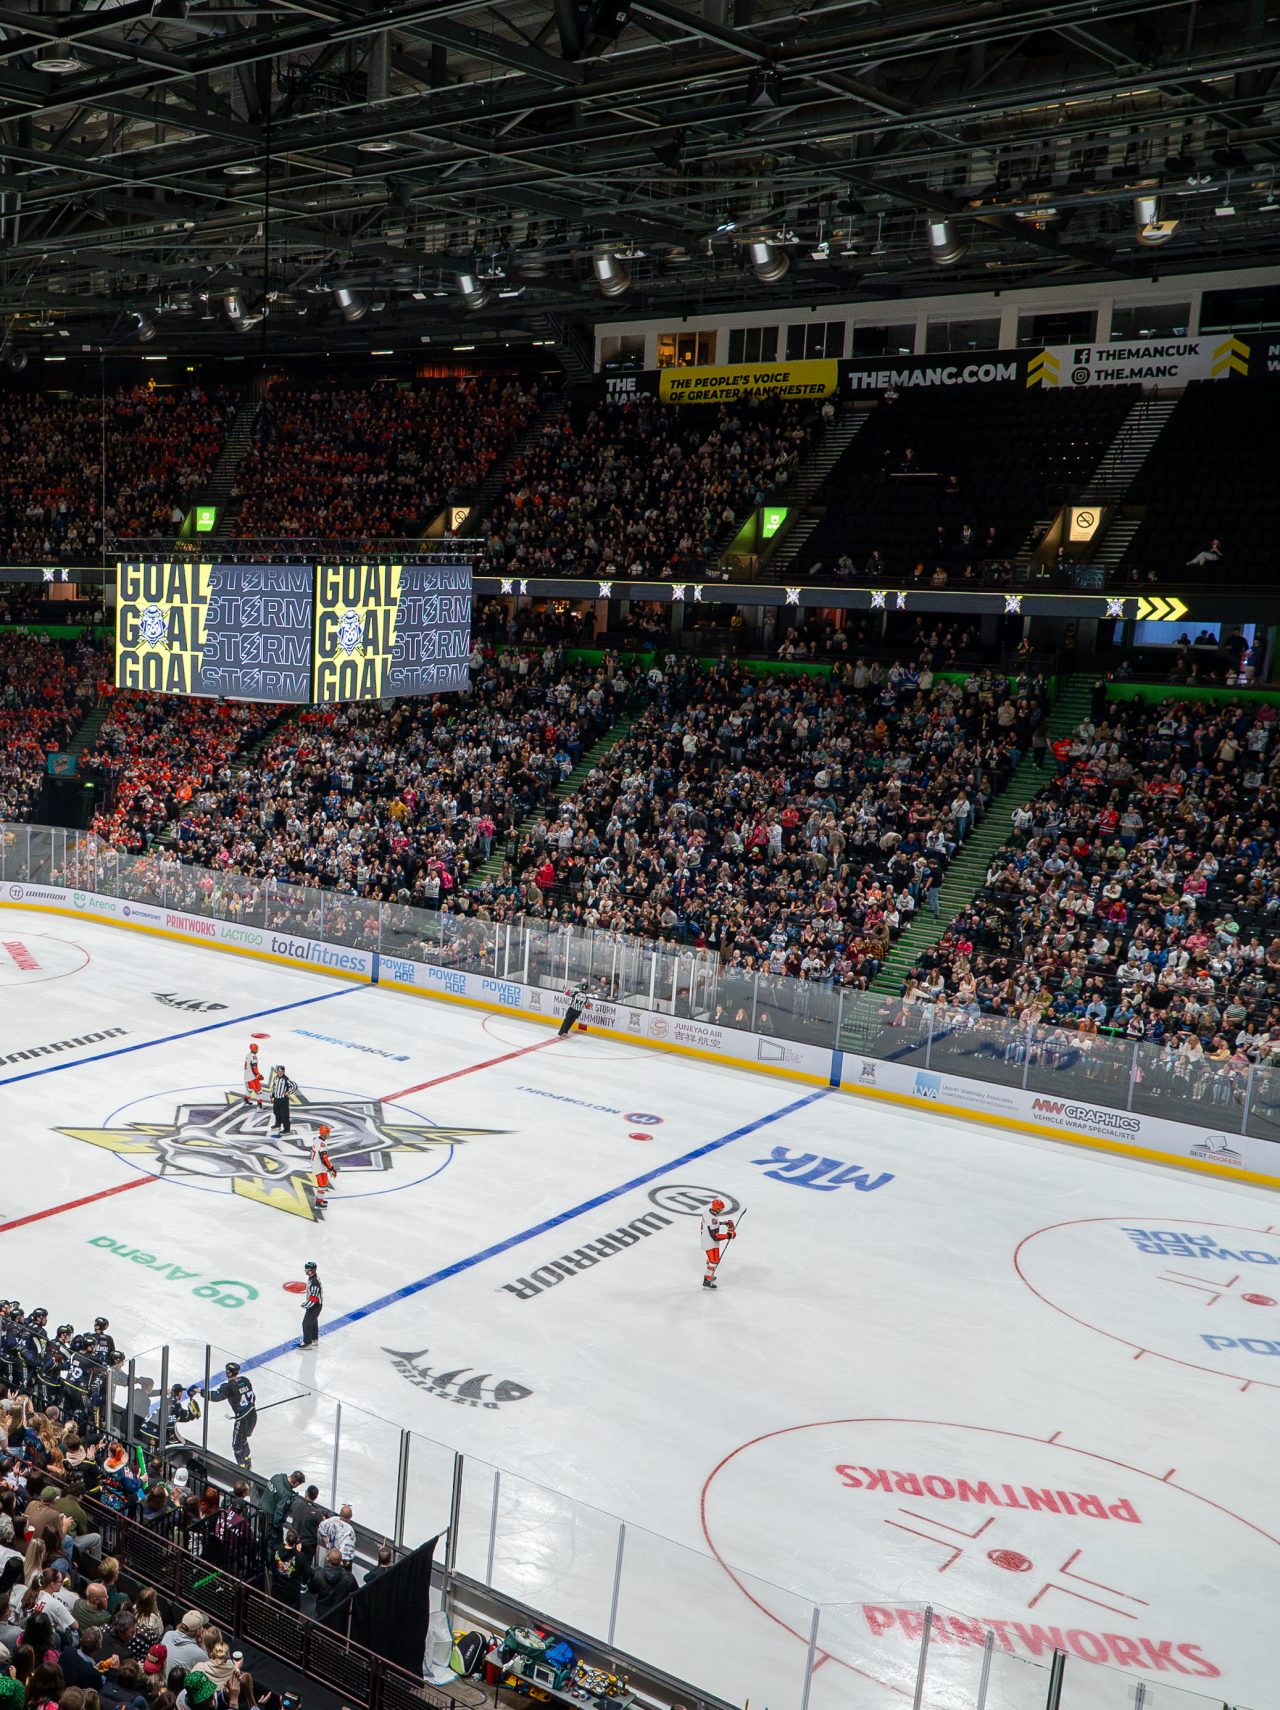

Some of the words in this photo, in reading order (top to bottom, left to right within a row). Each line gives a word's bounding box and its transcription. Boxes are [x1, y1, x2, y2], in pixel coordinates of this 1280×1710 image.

[1096, 343, 1200, 361] THEMANCUK
[670, 379, 686, 389] THE
[695, 375, 750, 388] PEOPLE'S
[754, 373, 790, 383] VOICE
[848, 362, 1018, 390] THEMANC.COM
[1094, 365, 1178, 380] THE.MANC
[605, 378, 636, 392] THE
[670, 391, 686, 401] OF
[687, 388, 740, 401] GREATER
[119, 564, 208, 605] GOAL
[320, 566, 399, 608] GOAL
[119, 604, 204, 653] GAL
[318, 609, 395, 659] GAL
[202, 632, 311, 666] STORM
[392, 629, 471, 662] STORM
[119, 651, 200, 694] GOAL
[316, 658, 390, 702] GOAL
[89, 898, 116, 911] Arena
[166, 914, 216, 937] PRINTWORKS
[221, 927, 263, 946] LACTIGO
[271, 935, 366, 972] totalfitness
[379, 957, 415, 974] POWER
[394, 970, 415, 983] ADE
[428, 968, 467, 984] POWER
[444, 981, 466, 994] ADE
[482, 979, 521, 997] POWER
[498, 993, 521, 1007] ADE
[594, 1003, 617, 1016] STORM
[579, 1012, 616, 1028] OMMUNITY
[674, 1022, 709, 1036] JUNEYAO
[710, 1030, 723, 1039] AIR
[515, 1085, 622, 1115] MOTORPOINT
[913, 1084, 939, 1099] LWA
[1033, 1113, 1064, 1125] VEHICLE
[1065, 1119, 1087, 1130] WRAP
[1088, 1125, 1136, 1141] SPECIALISTS
[1064, 1105, 1141, 1132] GRAPHICS
[750, 1145, 896, 1192] MTK
[1189, 1150, 1207, 1160] BEST
[1207, 1154, 1242, 1167] ROOFERS
[1120, 1227, 1218, 1247] ADE
[87, 1235, 201, 1281] Arena
[500, 1211, 675, 1300] WARRIOR
[1134, 1240, 1280, 1265] OWER
[834, 1463, 1142, 1524] PRINTWORKS
[861, 1603, 1222, 1679] PRINTWORKS
